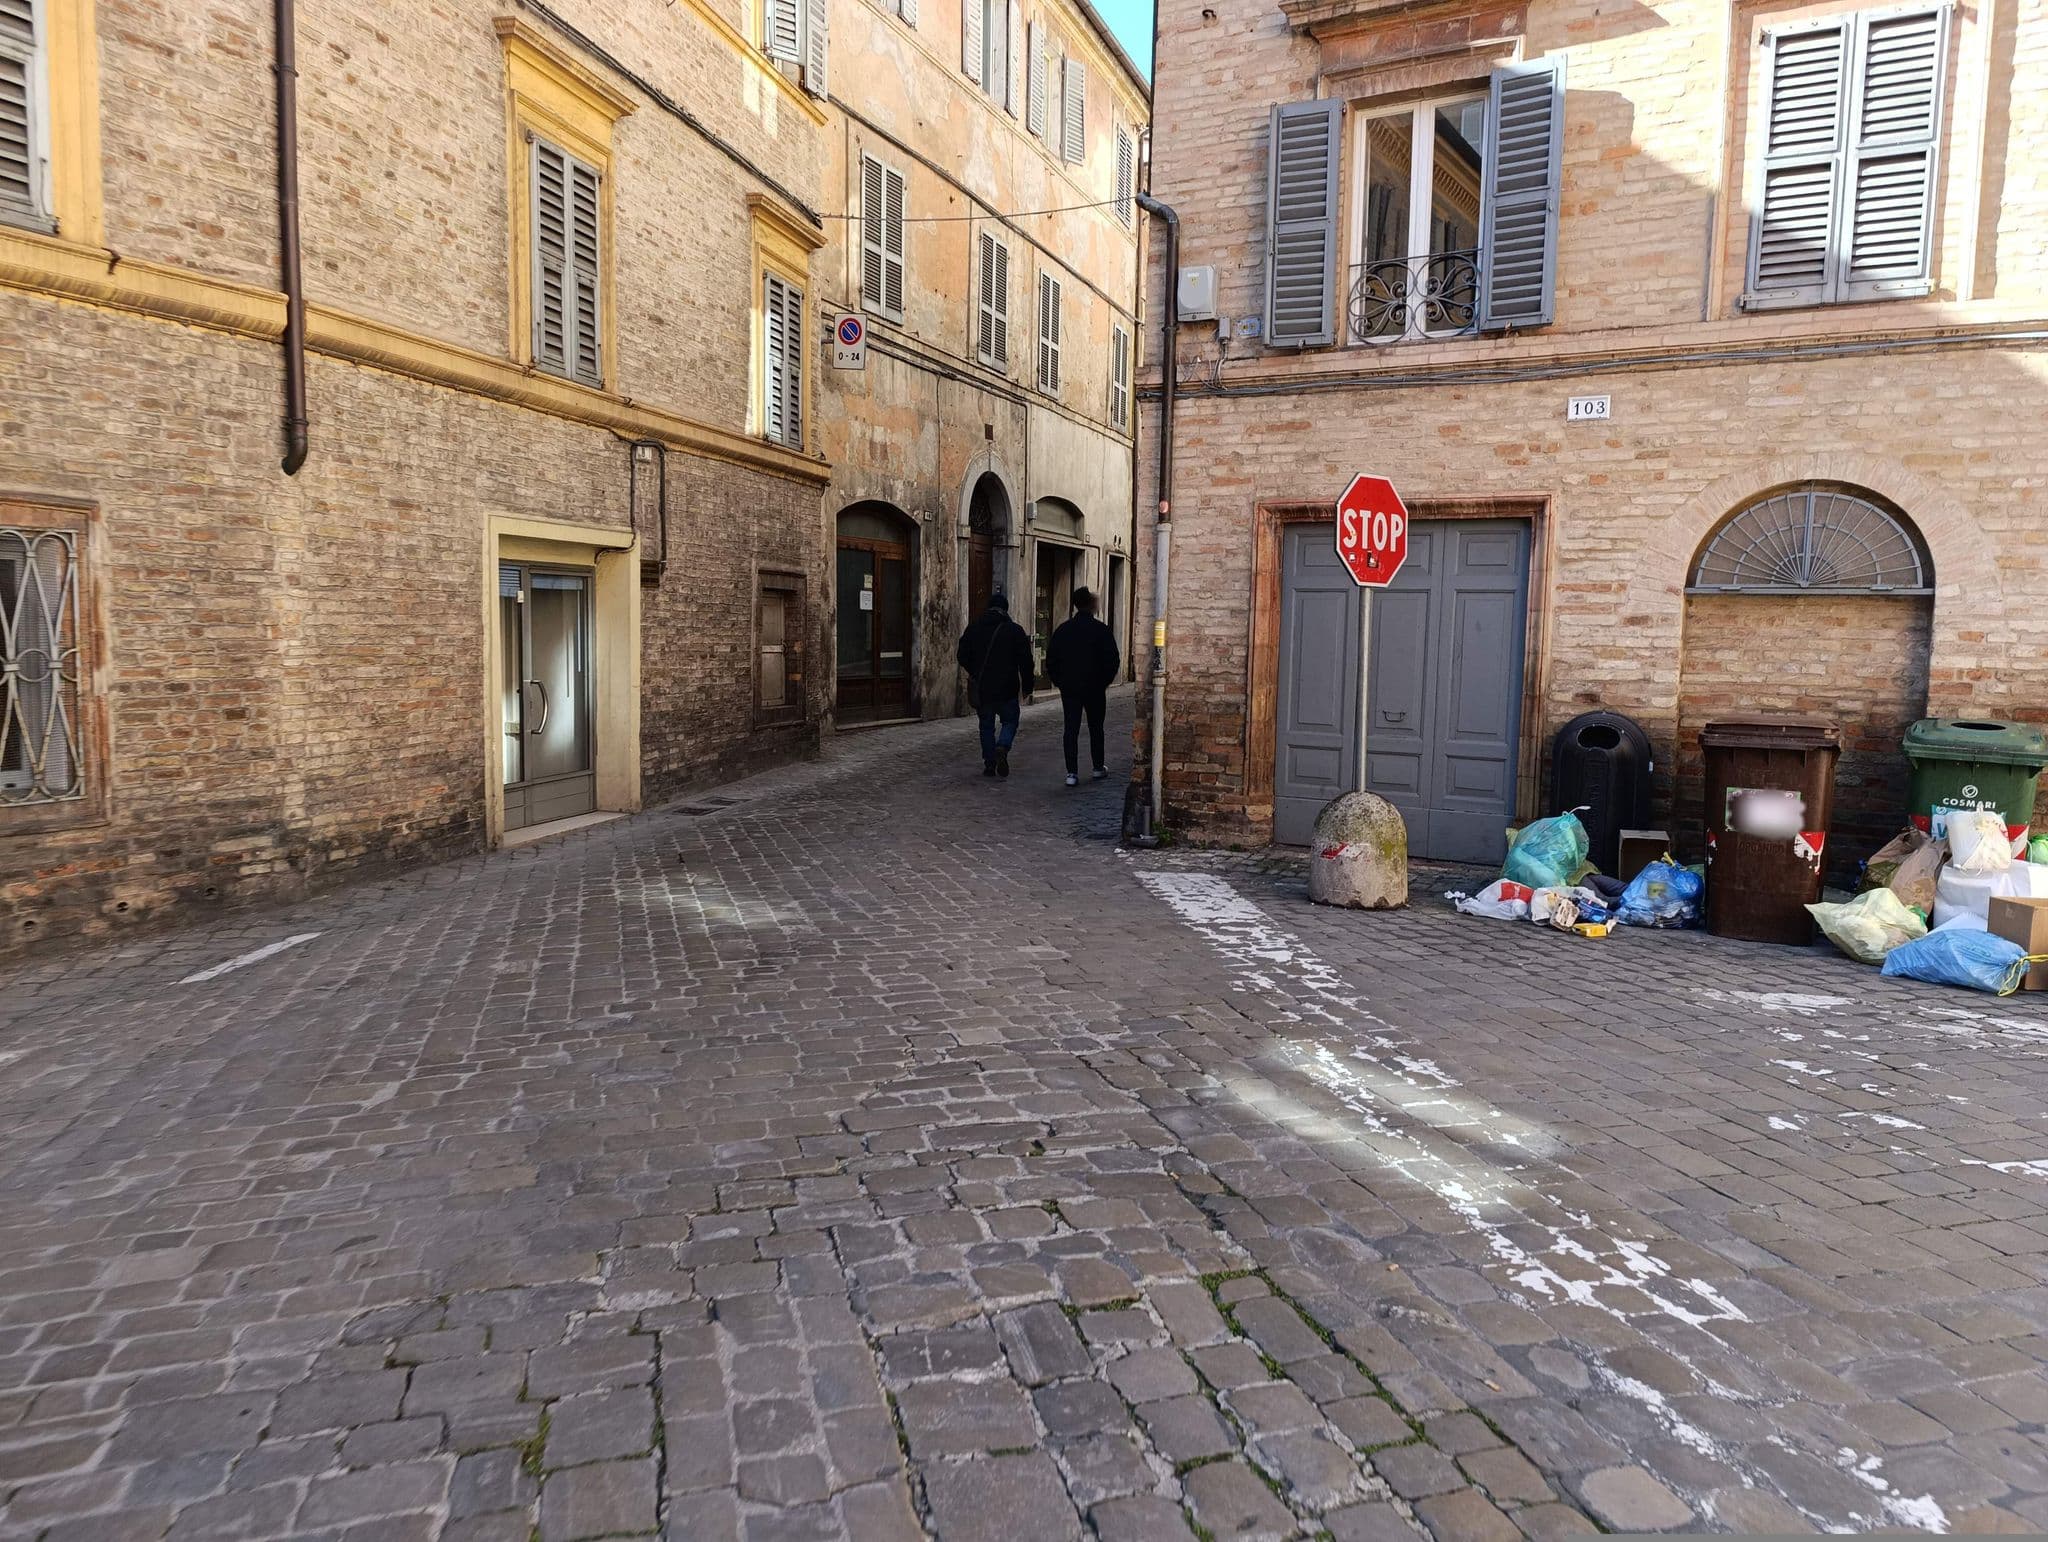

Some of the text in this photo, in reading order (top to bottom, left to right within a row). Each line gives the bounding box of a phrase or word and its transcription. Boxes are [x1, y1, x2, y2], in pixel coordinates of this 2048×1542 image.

[838, 352, 844, 360] 0
[851, 352, 860, 360] 24
[1574, 401, 1606, 416] 103
[1343, 508, 1404, 552] STOP
[1942, 798, 1996, 809] COSMARI
